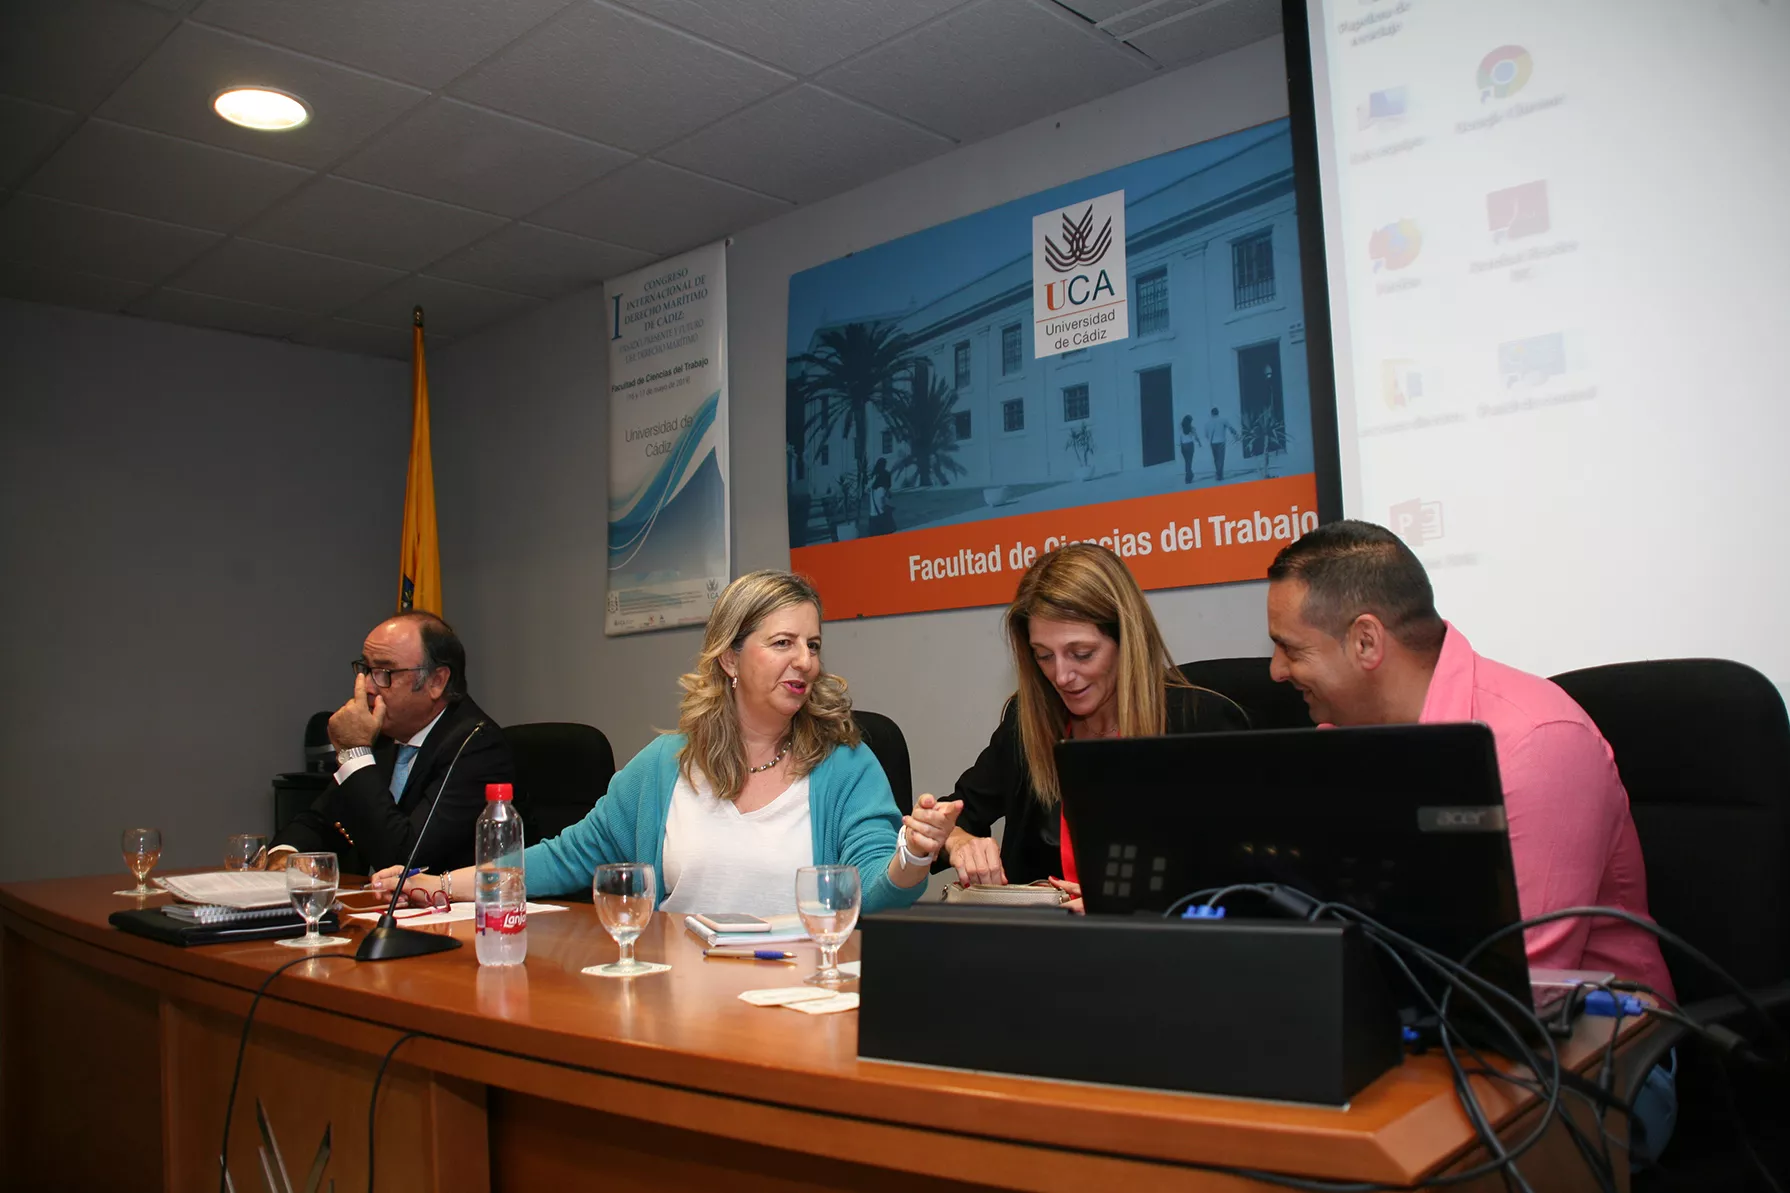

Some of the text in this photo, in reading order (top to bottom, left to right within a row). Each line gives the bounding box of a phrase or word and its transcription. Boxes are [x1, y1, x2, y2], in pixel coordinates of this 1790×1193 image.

[626, 274, 707, 311] INTERNACIONAL DE
[643, 267, 689, 292] CONGRESO
[1044, 268, 1116, 312] UCA
[611, 292, 624, 341] I
[624, 305, 662, 325] DERECHO
[644, 320, 656, 332] DE
[1045, 308, 1116, 336] Universidad
[1054, 327, 1108, 350] de Cádiz
[611, 356, 709, 393] Facultad de Ciencias del Trabajo
[624, 413, 694, 443] Universidad de
[645, 440, 672, 458] Cádiz
[908, 543, 1003, 582] Facultad
[1008, 541, 1037, 571] de
[1160, 517, 1203, 553] del
[1207, 505, 1320, 546] Trabajo
